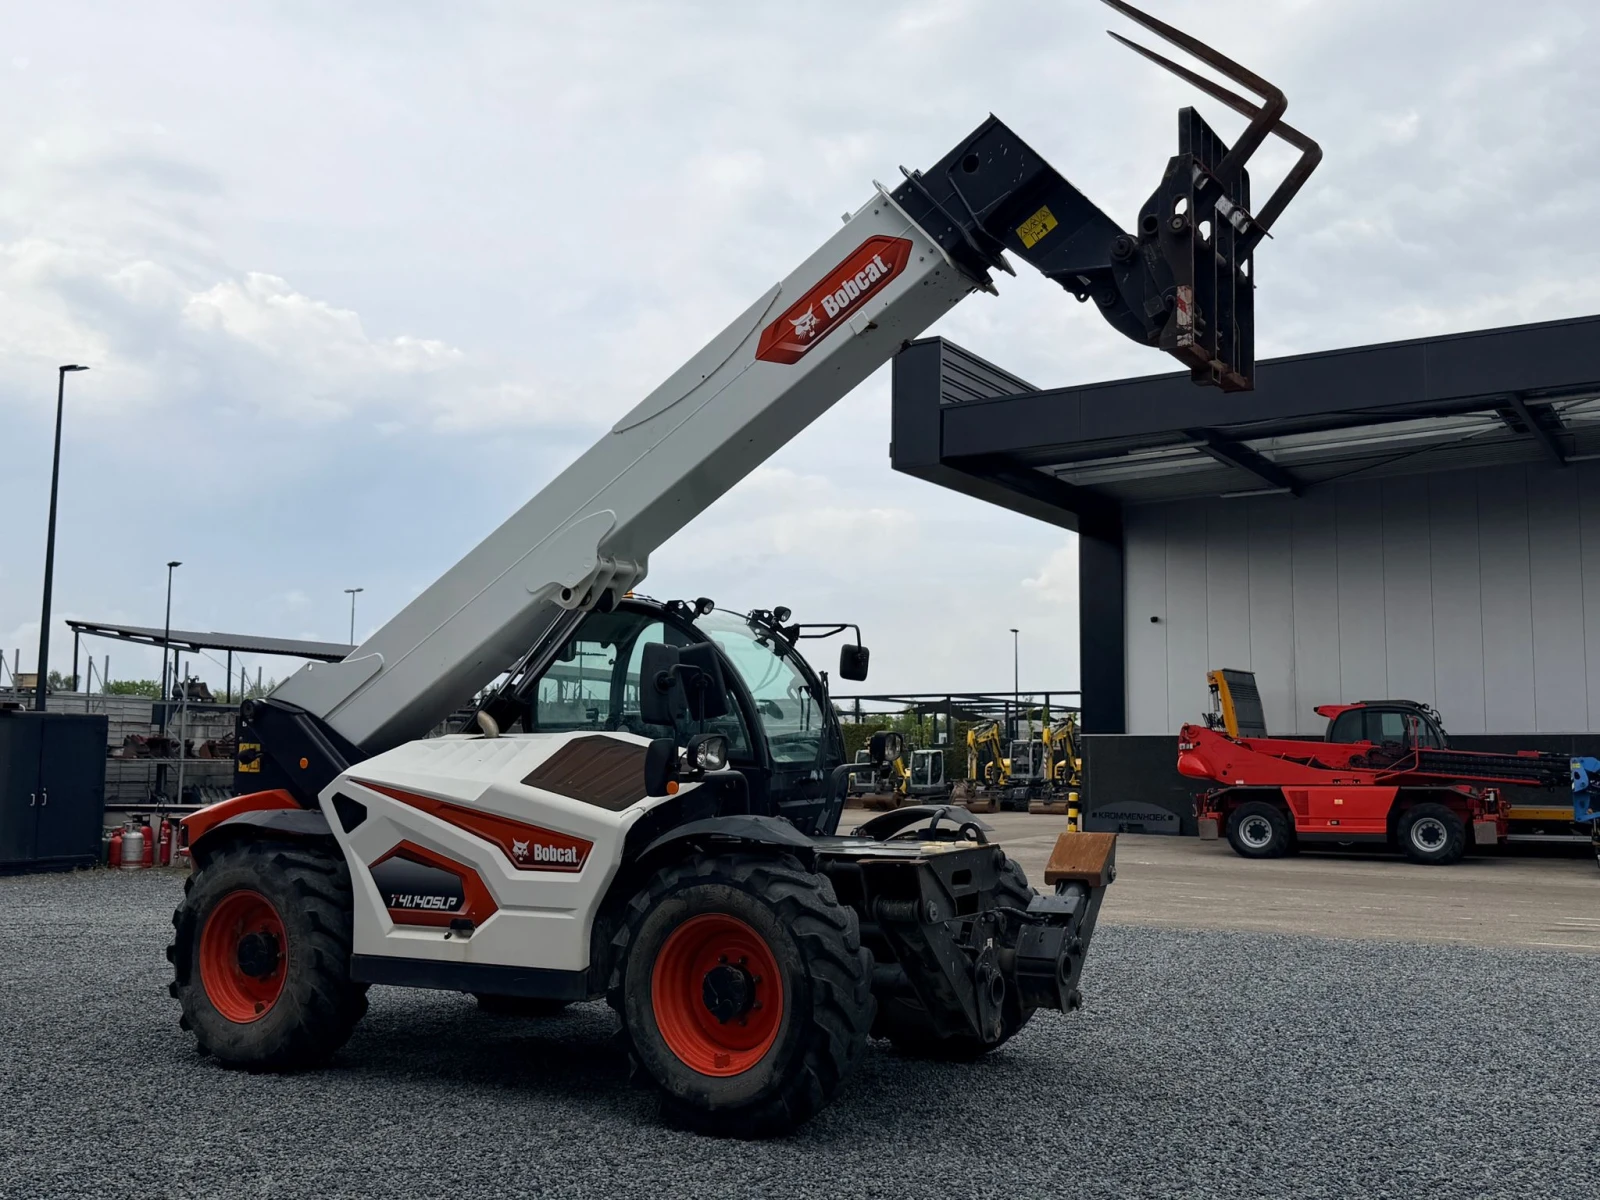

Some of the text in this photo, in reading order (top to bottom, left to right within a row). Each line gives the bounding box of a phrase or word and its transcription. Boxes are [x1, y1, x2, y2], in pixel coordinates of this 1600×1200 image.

[821, 254, 888, 319] Bobcat
[1098, 811, 1167, 821] KROMMENHOEK
[533, 843, 577, 863] Bobcat
